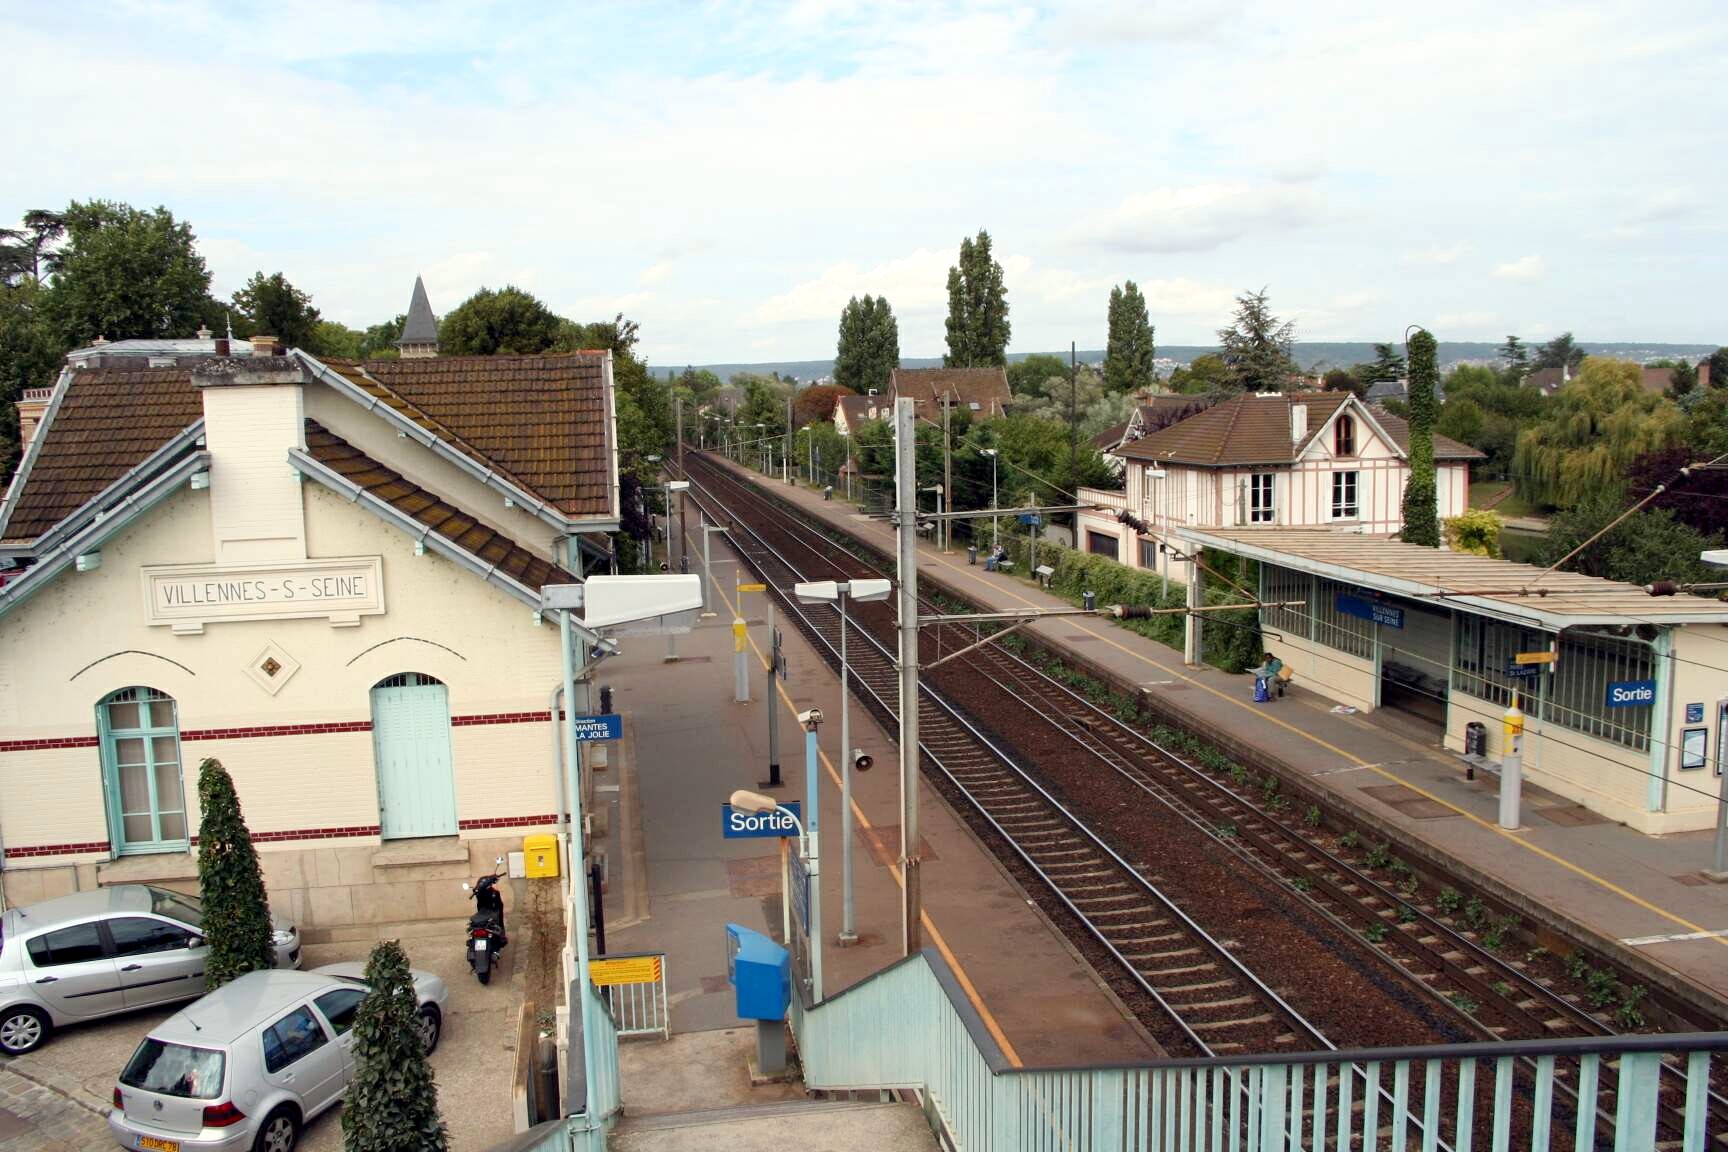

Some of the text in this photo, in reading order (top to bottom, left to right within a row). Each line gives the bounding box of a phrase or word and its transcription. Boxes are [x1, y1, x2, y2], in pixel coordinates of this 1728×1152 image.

[1613, 686, 1652, 701] Sortie
[575, 723, 608, 731] MANTES
[588, 731, 610, 739] JOLIE
[730, 812, 794, 831] Sortie
